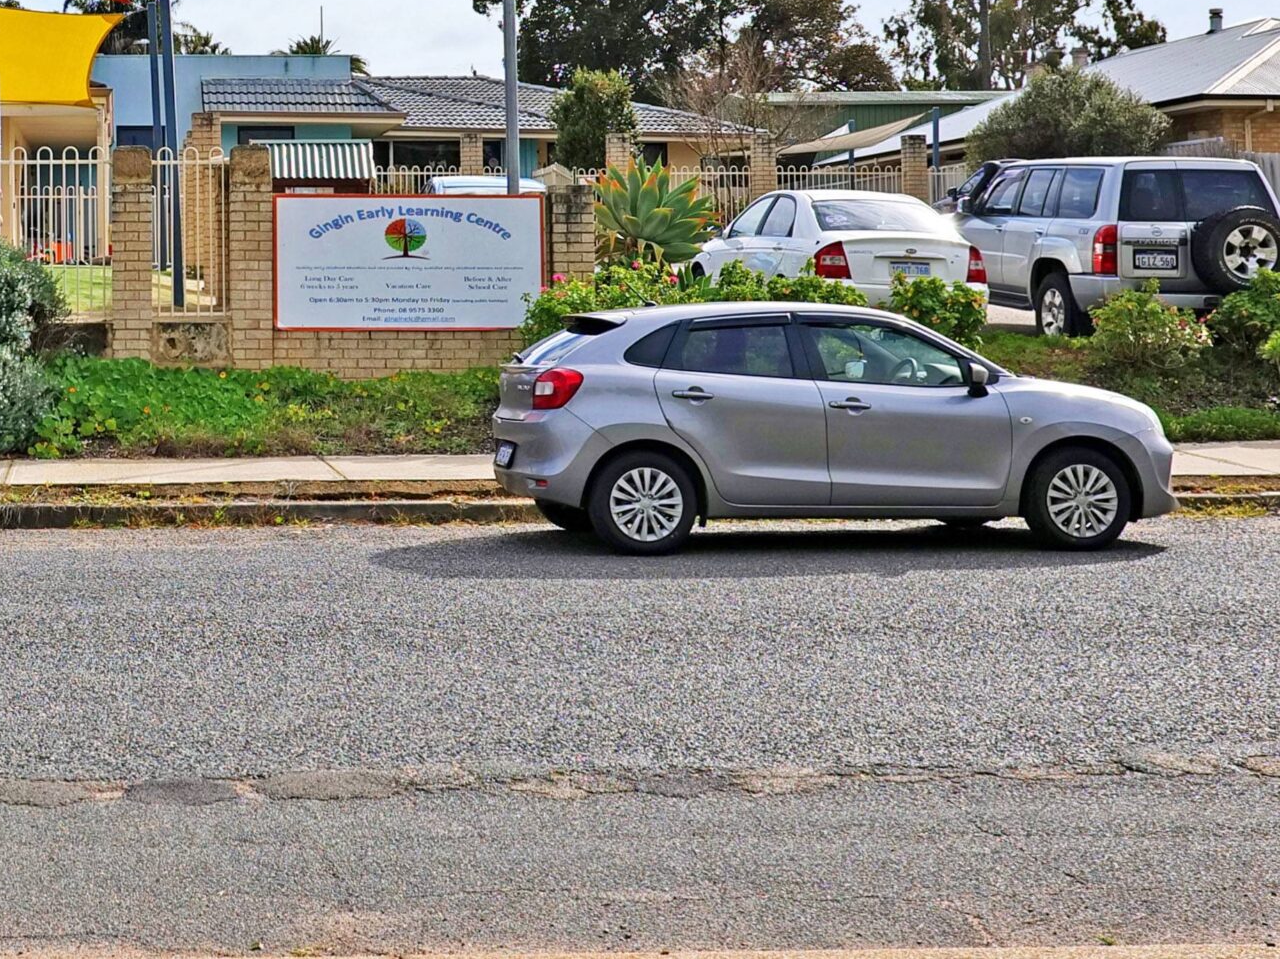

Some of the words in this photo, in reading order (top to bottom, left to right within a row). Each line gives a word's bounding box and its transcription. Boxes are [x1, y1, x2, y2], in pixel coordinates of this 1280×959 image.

[308, 214, 354, 239] Gingin
[356, 206, 394, 220] Early
[398, 205, 463, 223] Learning
[466, 212, 511, 241] Centre
